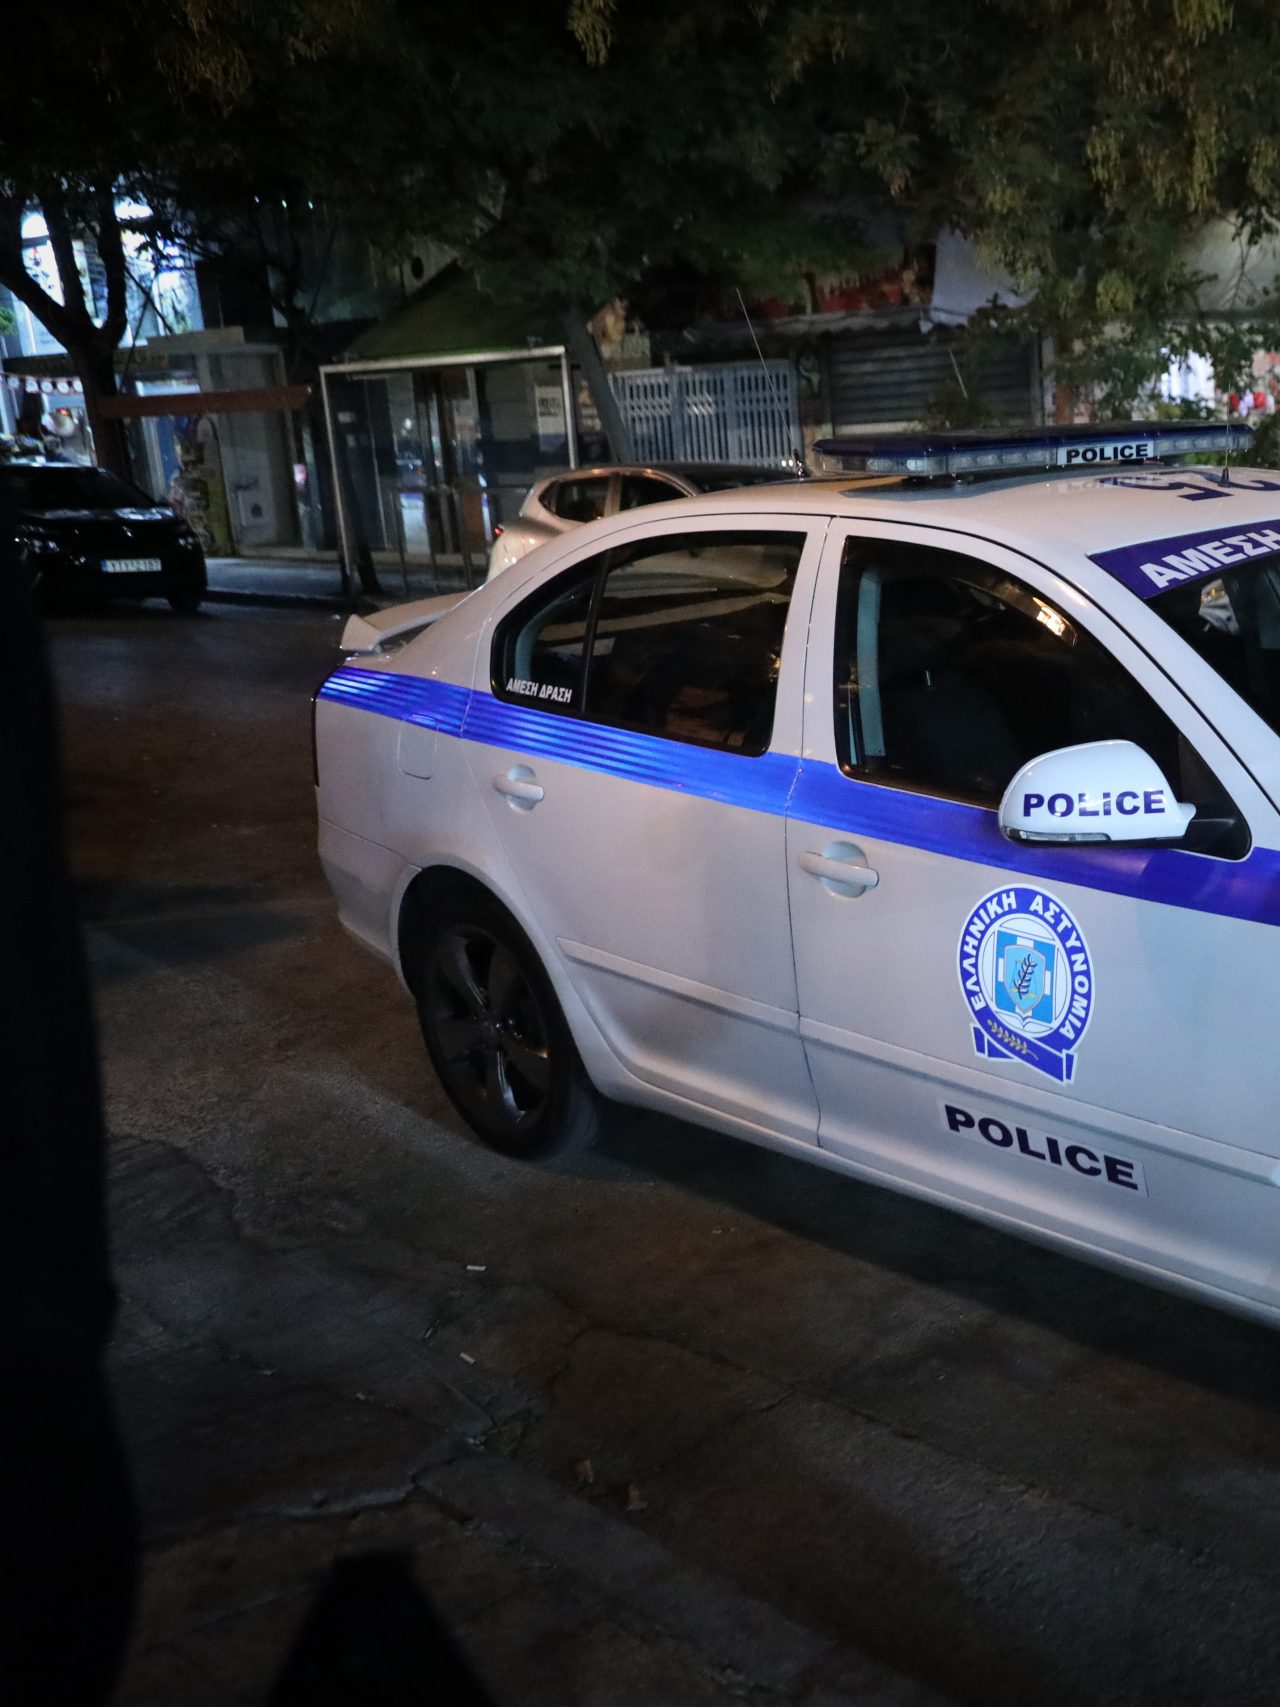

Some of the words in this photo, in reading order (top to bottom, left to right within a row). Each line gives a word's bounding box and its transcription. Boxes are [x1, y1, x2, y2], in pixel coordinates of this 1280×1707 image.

[1065, 443, 1149, 464] POLICE
[505, 678, 539, 697] ΑΜΕΣΗ
[538, 684, 573, 704] ΔΡΑΣΗ
[1023, 789, 1166, 818] POLICE
[962, 890, 1018, 1012] ΕΛΛΗΝΙΚΗ
[1028, 895, 1090, 1041] ΑΣΤΥΝΟΜΙΑ
[944, 1103, 1139, 1191] POLICE
